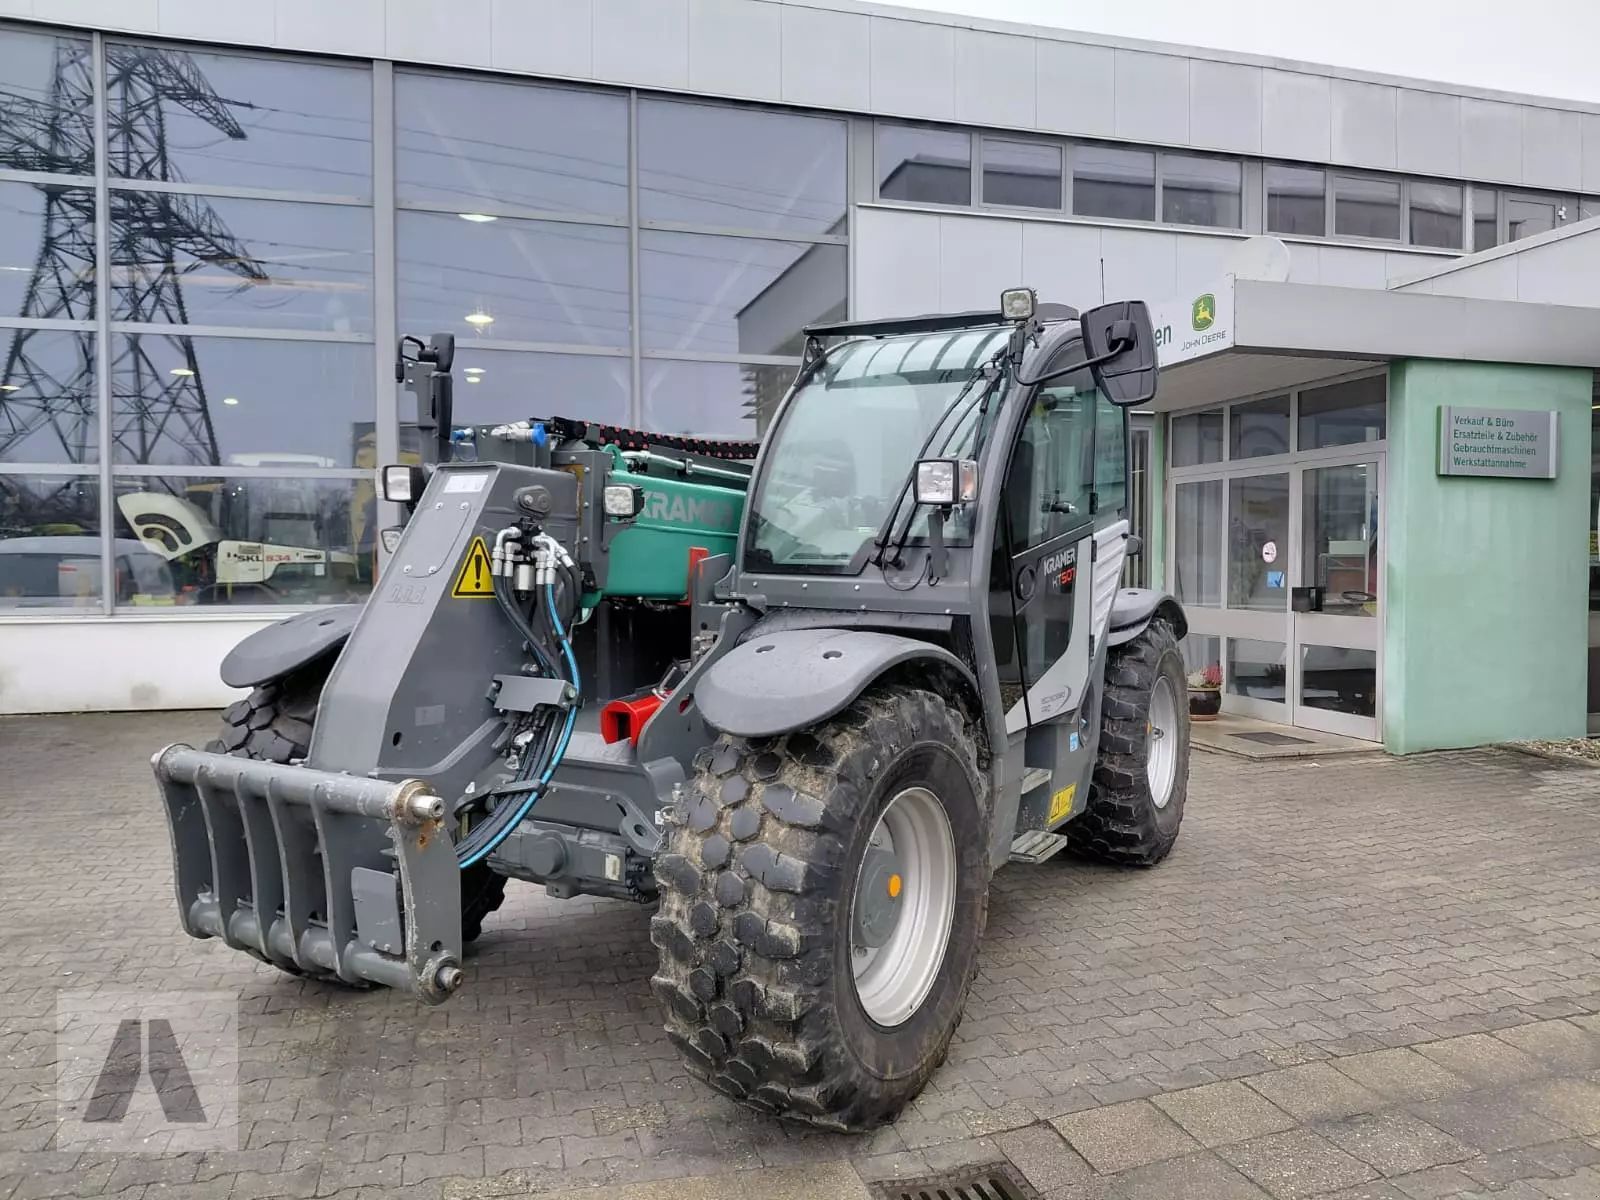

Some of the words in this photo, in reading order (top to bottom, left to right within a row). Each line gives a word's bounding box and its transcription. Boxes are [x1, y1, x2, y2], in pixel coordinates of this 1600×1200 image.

[1154, 325, 1172, 347] en
[1201, 330, 1227, 345] DEERE
[1454, 415, 1485, 426] Verkauf
[1487, 416, 1494, 427] &
[1496, 418, 1515, 428] Büro
[1453, 429, 1495, 440] Ersatzteile
[1497, 431, 1504, 441] &
[1506, 432, 1538, 442] Zubehör
[1453, 443, 1537, 456] Gebrauchtmaschinen
[1453, 457, 1528, 468] Werkstattannahme
[1043, 548, 1076, 576] KRAMER
